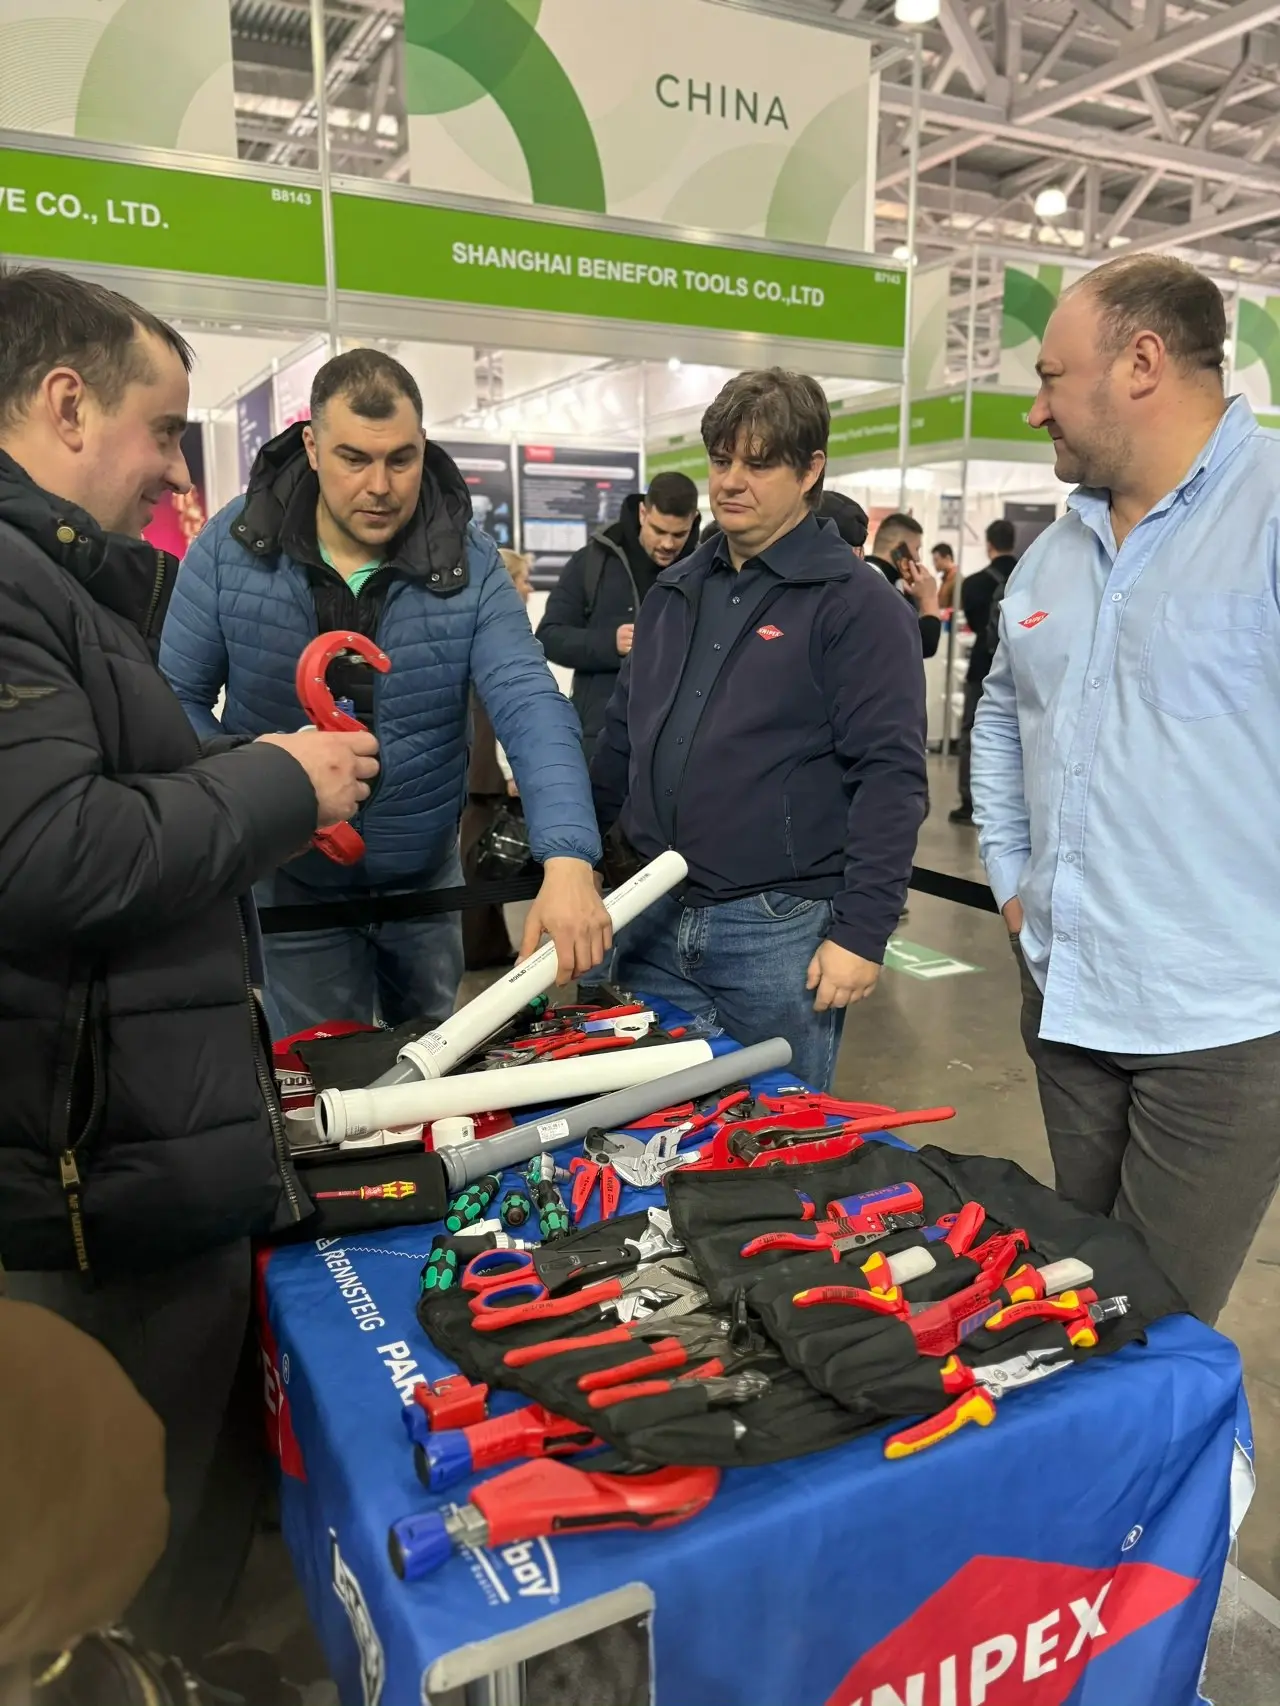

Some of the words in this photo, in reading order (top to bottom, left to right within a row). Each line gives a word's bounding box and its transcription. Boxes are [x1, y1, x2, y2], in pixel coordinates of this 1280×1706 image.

[656, 73, 789, 130] CHINA
[36, 191, 98, 225] CO.,
[107, 199, 170, 229] LTD.
[271, 188, 313, 206] B8143
[452, 241, 571, 276] SHANGHAI
[577, 257, 678, 289] BENEFOR
[683, 270, 749, 298] TOOLS
[753, 280, 825, 307] CO.,LTD
[316, 1248, 386, 1332] RENNSTEIG
[501, 1538, 554, 1597] boy
